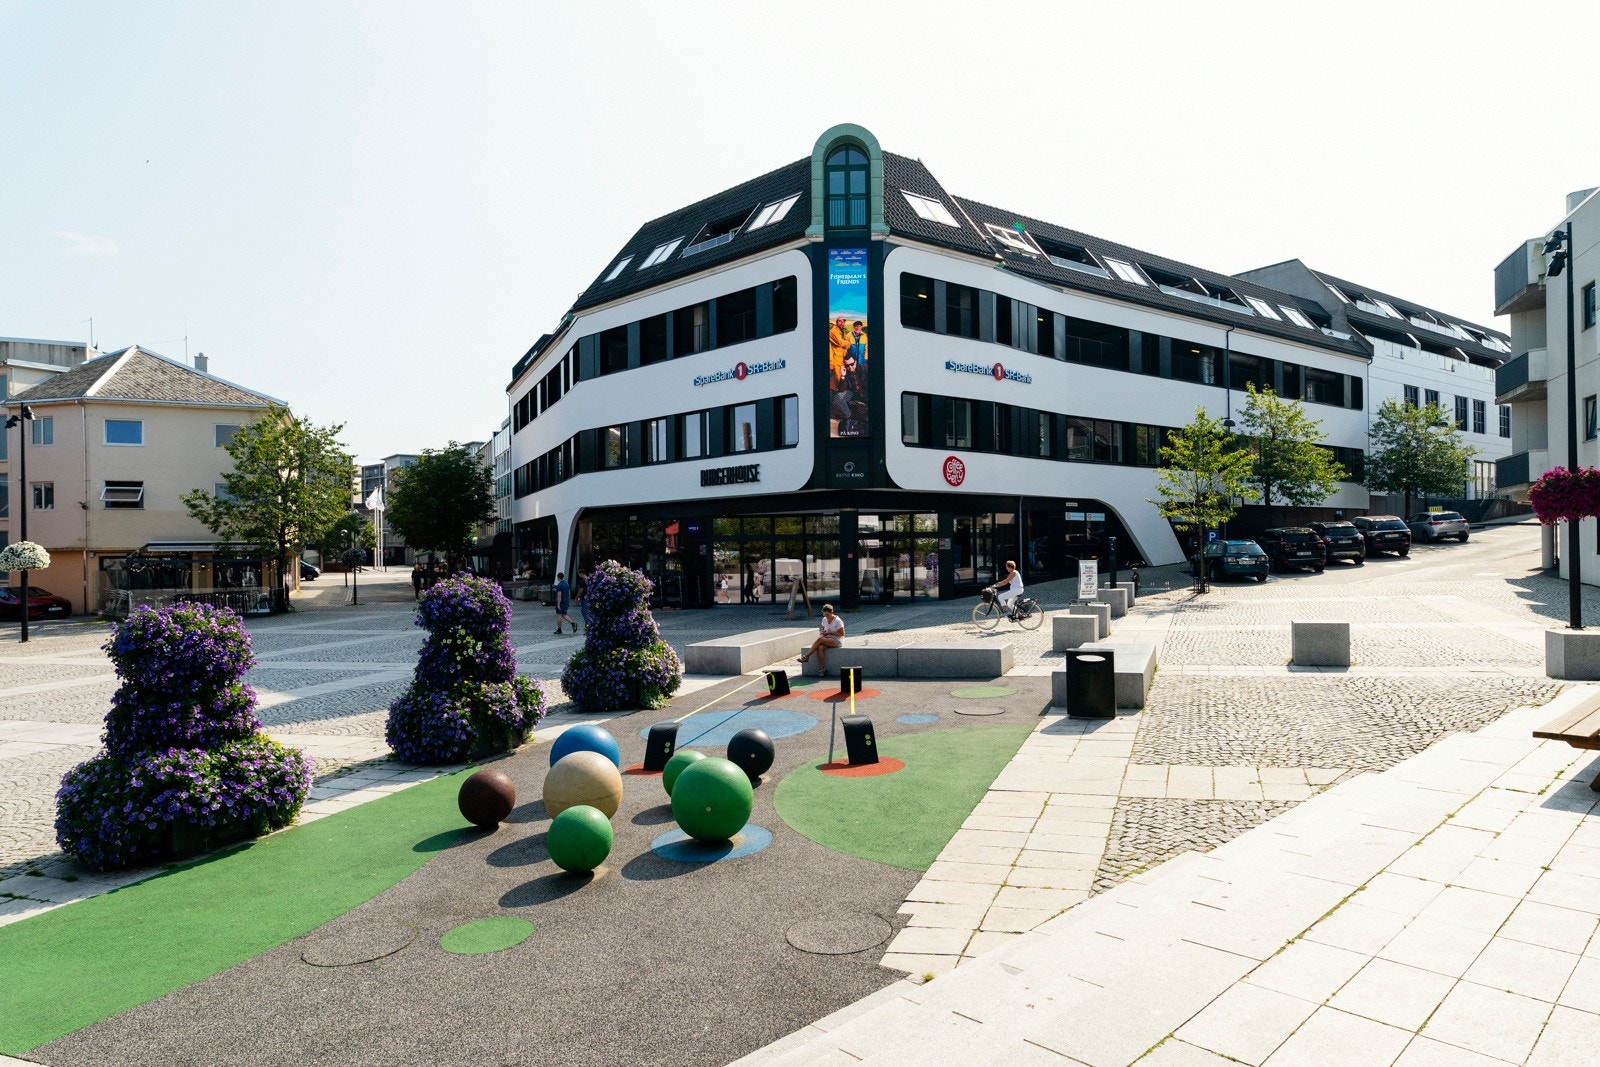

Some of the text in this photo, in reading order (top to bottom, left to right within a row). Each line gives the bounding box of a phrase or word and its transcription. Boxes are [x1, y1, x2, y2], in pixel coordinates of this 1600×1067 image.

[694, 368, 735, 387] SpareBank
[747, 358, 784, 375] SR-Bank
[949, 360, 994, 376] SpareBank
[1004, 368, 1033, 384] SR-Bank
[700, 463, 761, 487] BURGERHOUSE
[1209, 531, 1217, 542] P
